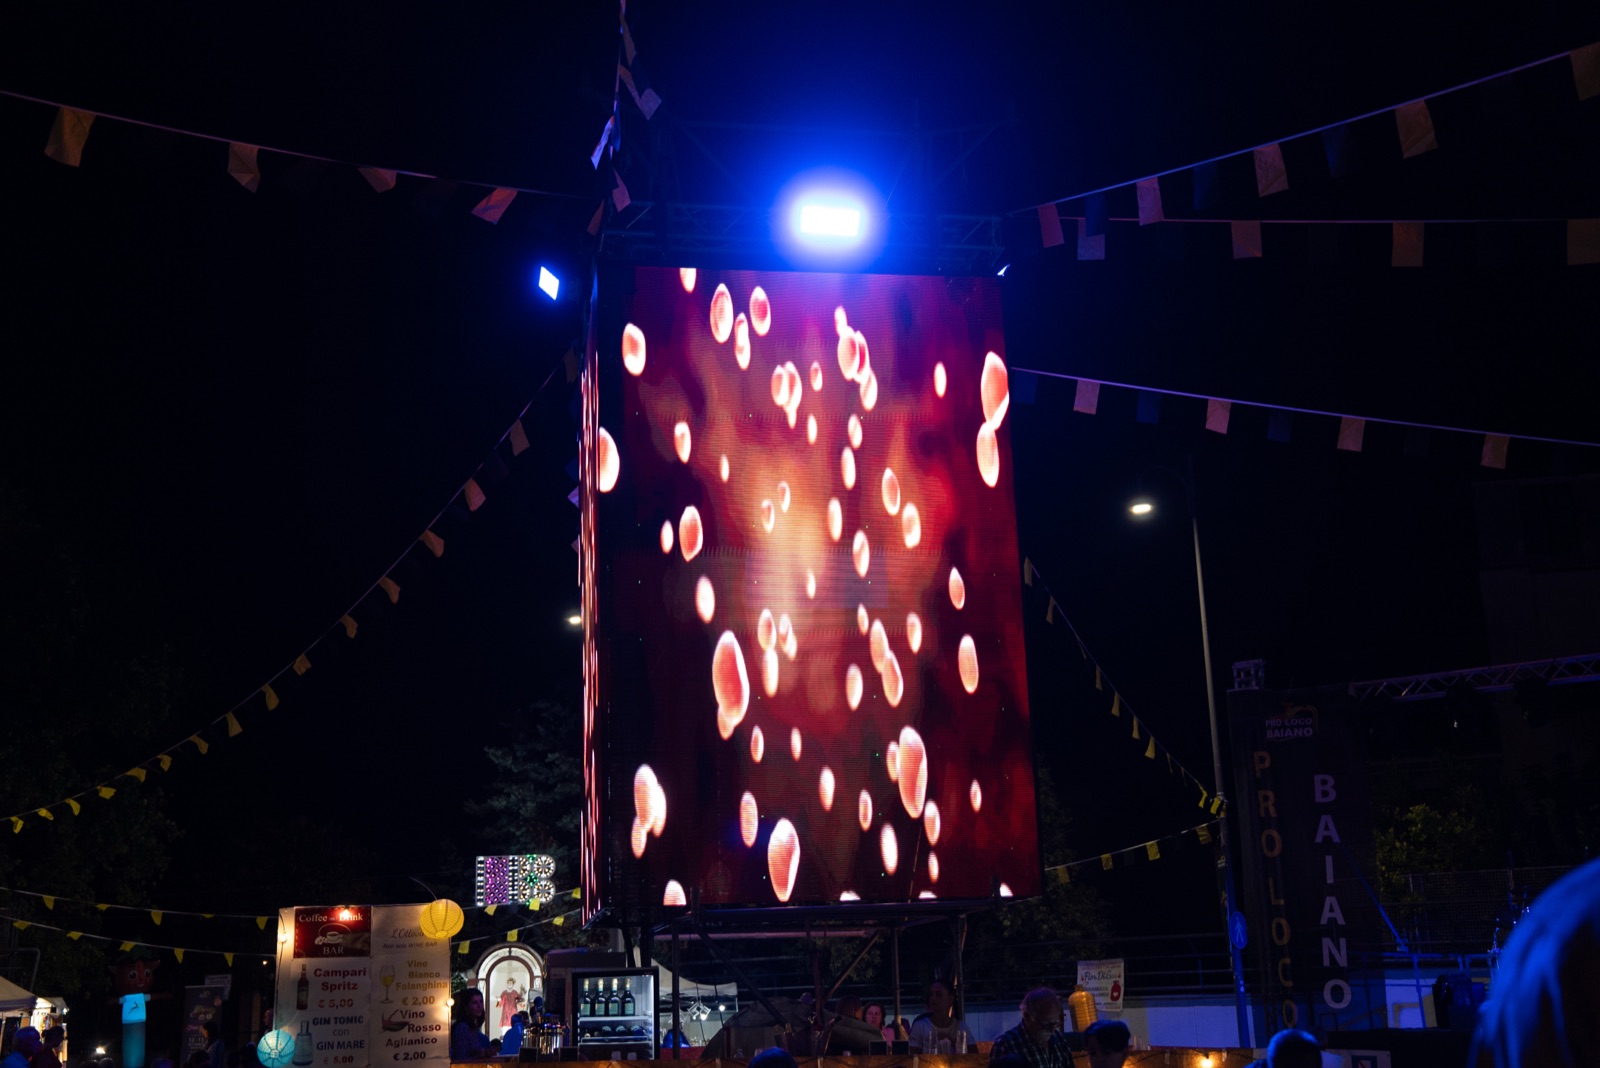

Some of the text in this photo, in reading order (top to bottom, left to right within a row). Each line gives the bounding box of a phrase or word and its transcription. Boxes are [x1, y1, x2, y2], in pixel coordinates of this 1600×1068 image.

[1285, 717, 1313, 726] LOCO
[1266, 727, 1313, 739] BAIANO
[1313, 773, 1352, 1010] BAIANO
[299, 913, 328, 922] Coffee
[323, 946, 344, 954] BAR
[407, 960, 428, 968] Vino
[314, 968, 367, 979] Campari
[408, 971, 441, 979] Bianco
[321, 981, 358, 993] Spritz
[396, 980, 448, 991] Falanghina
[328, 998, 354, 1009] 5,00
[401, 996, 435, 1006] € 2,00
[400, 1009, 425, 1019] Vino
[312, 1015, 364, 1026] GIN TONIC
[333, 1028, 350, 1036] con
[407, 1023, 441, 1033] Rosso
[316, 1040, 365, 1051] GIN MARE
[385, 1036, 437, 1048] Aglianico
[393, 1051, 426, 1061] € 2,00
